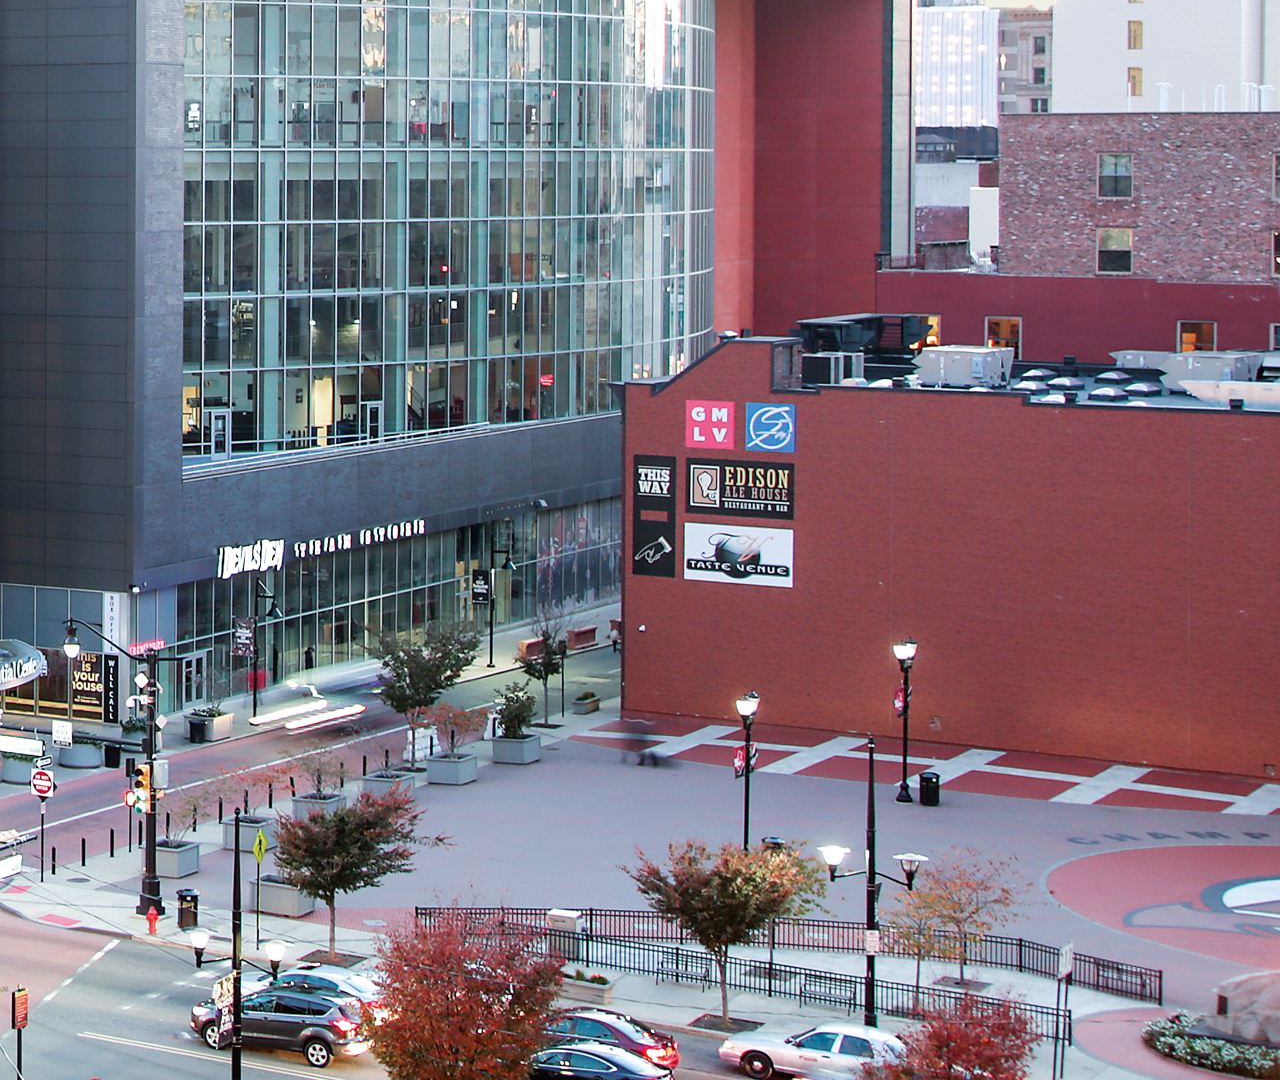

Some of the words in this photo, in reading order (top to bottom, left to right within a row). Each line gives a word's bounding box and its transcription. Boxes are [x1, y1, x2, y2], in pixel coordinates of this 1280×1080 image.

[638, 469, 670, 482] THIS
[724, 466, 789, 489] EDISON
[638, 481, 671, 494] WAY
[724, 485, 745, 499] ALE
[751, 487, 788, 501] HOUSE
[724, 501, 765, 511] RESTAURANT
[776, 504, 788, 512] BAR
[219, 539, 262, 580] DEVILS
[689, 560, 731, 571] TASTE
[736, 563, 788, 575] VENUE
[73, 671, 100, 682] your
[108, 660, 116, 688] WILL
[108, 692, 116, 720] CALL
